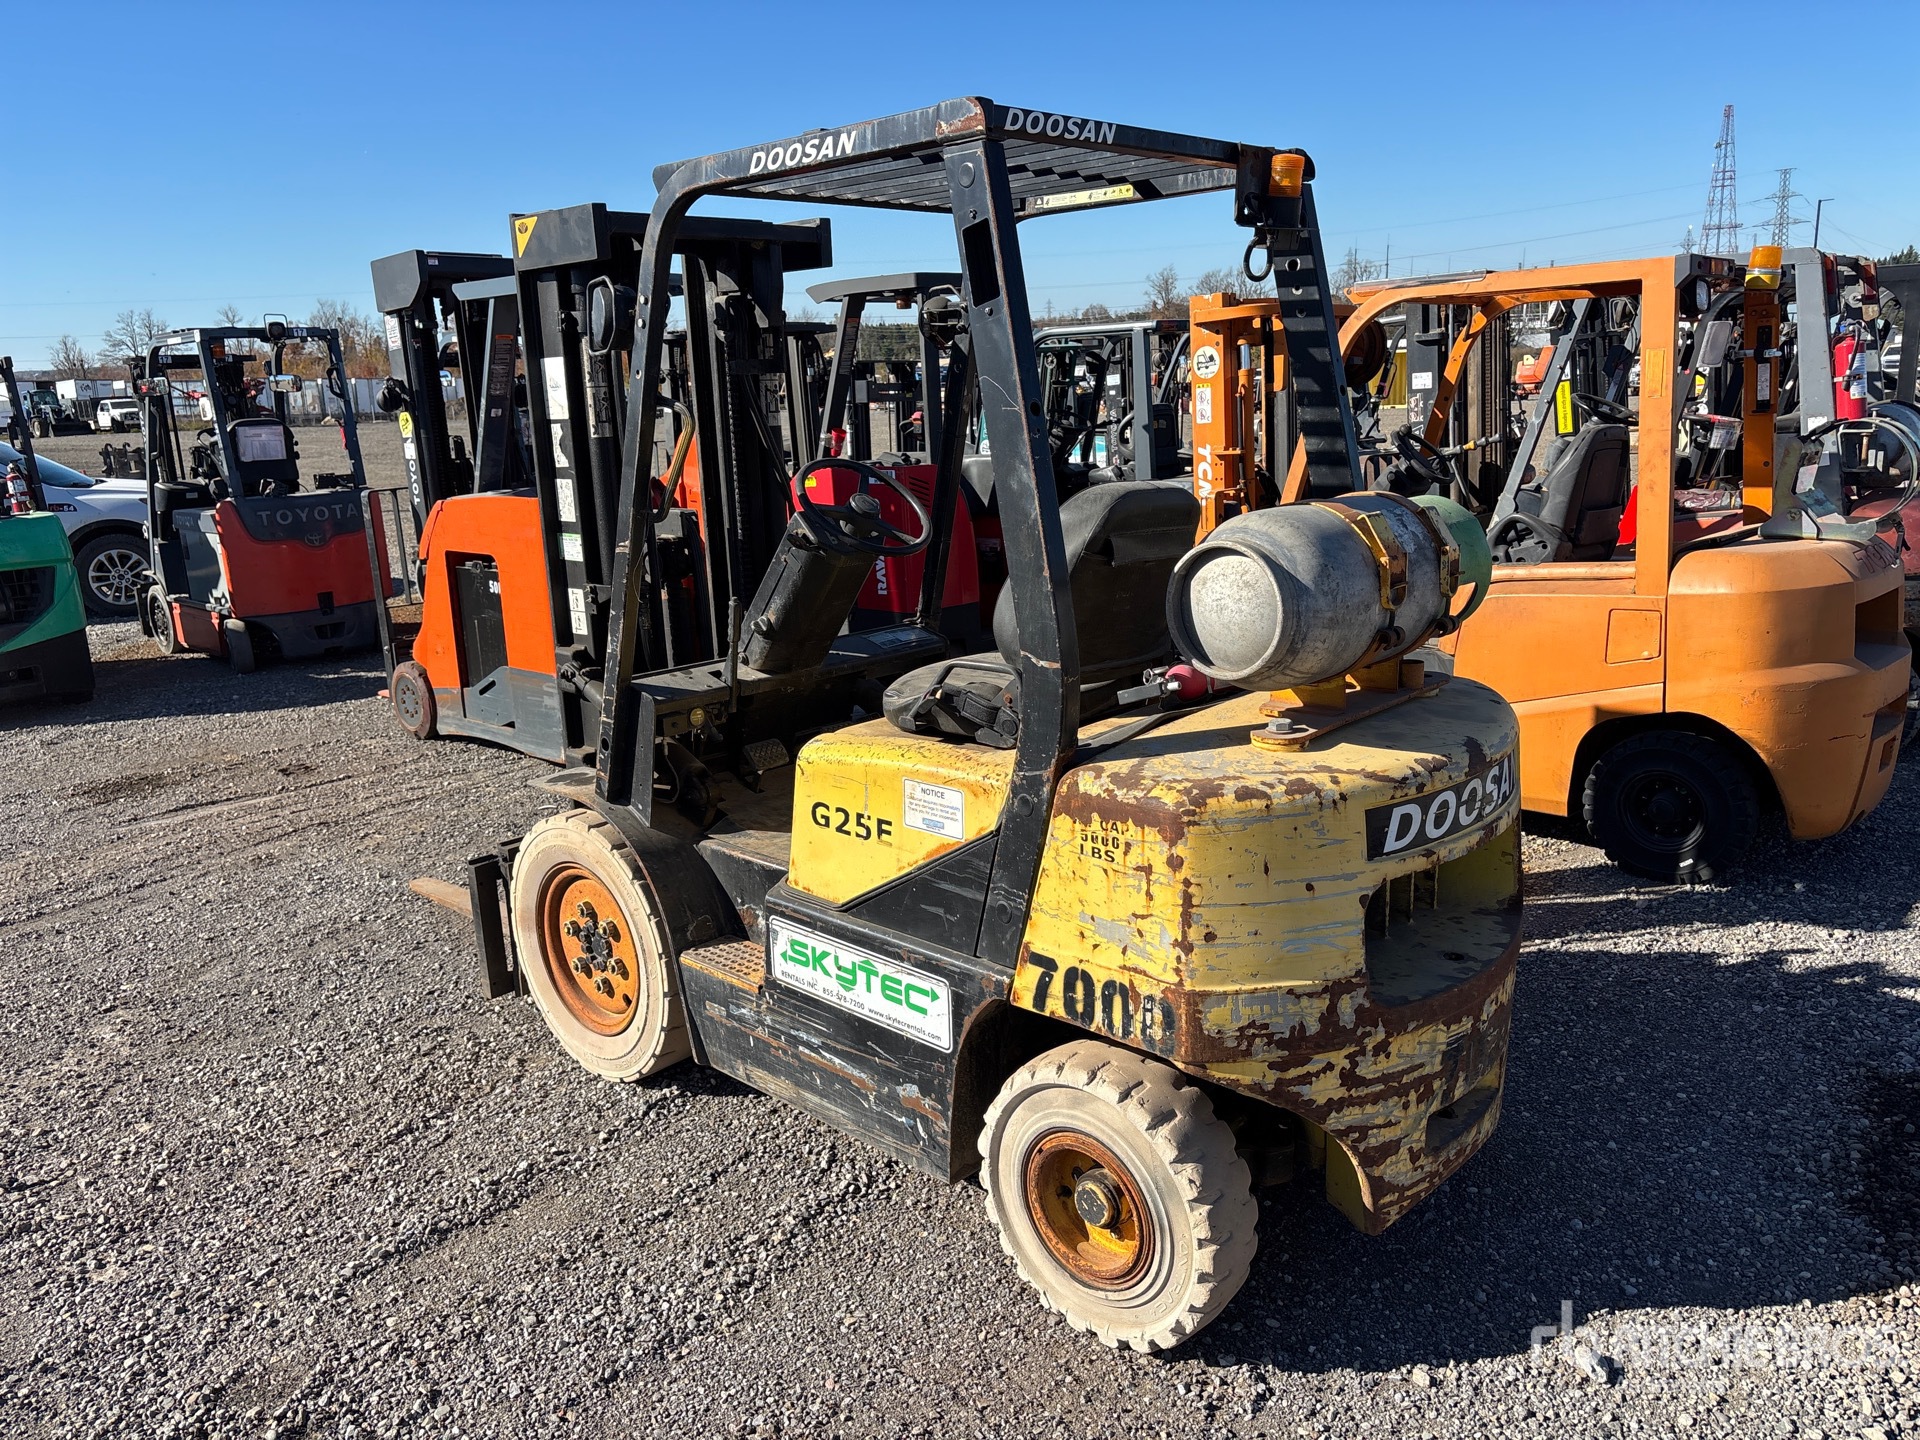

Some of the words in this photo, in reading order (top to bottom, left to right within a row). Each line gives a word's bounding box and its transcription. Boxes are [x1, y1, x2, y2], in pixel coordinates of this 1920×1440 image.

[1004, 108, 1117, 145] DOOSAN
[748, 130, 857, 174] DOOSAN
[256, 502, 359, 526] TOYOTA
[920, 787, 946, 800] NOTICE
[781, 969, 806, 987] RENTALS
[805, 979, 820, 993] INC.
[868, 1006, 942, 1042] www.skytecrentals.com
